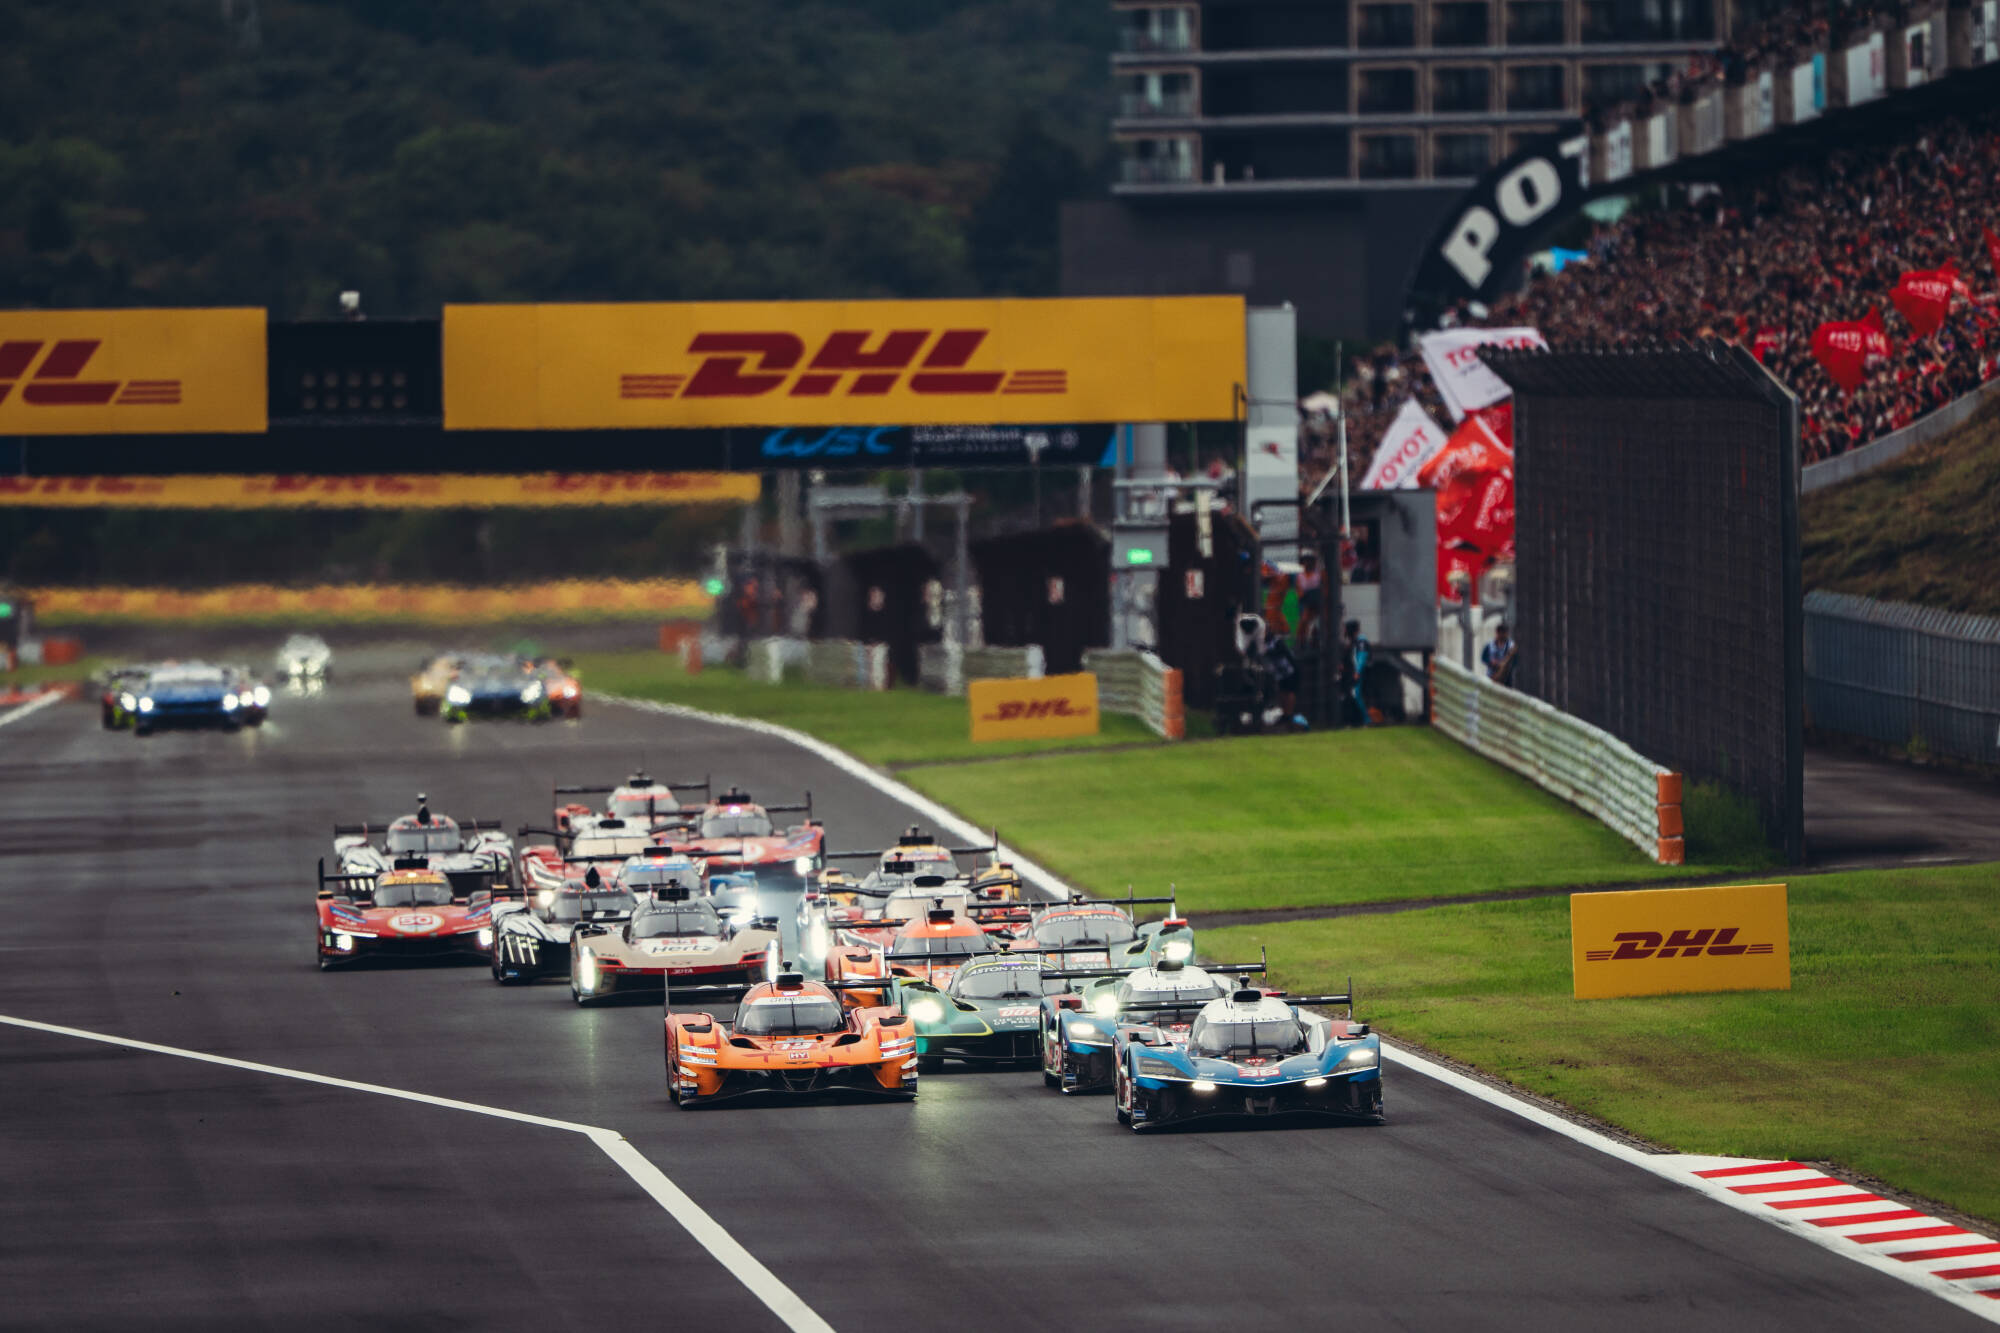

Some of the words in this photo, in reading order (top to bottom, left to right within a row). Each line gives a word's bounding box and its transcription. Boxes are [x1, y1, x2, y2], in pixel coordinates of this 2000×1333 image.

[681, 329, 1006, 397] DHL
[998, 698, 1074, 721] DHL
[400, 916, 433, 926] 50
[652, 944, 713, 954] Hertz
[1612, 928, 1748, 961] DHL
[970, 965, 1008, 976] ASTON
[789, 1052, 809, 1060] HY
[1239, 1067, 1280, 1078] 36
